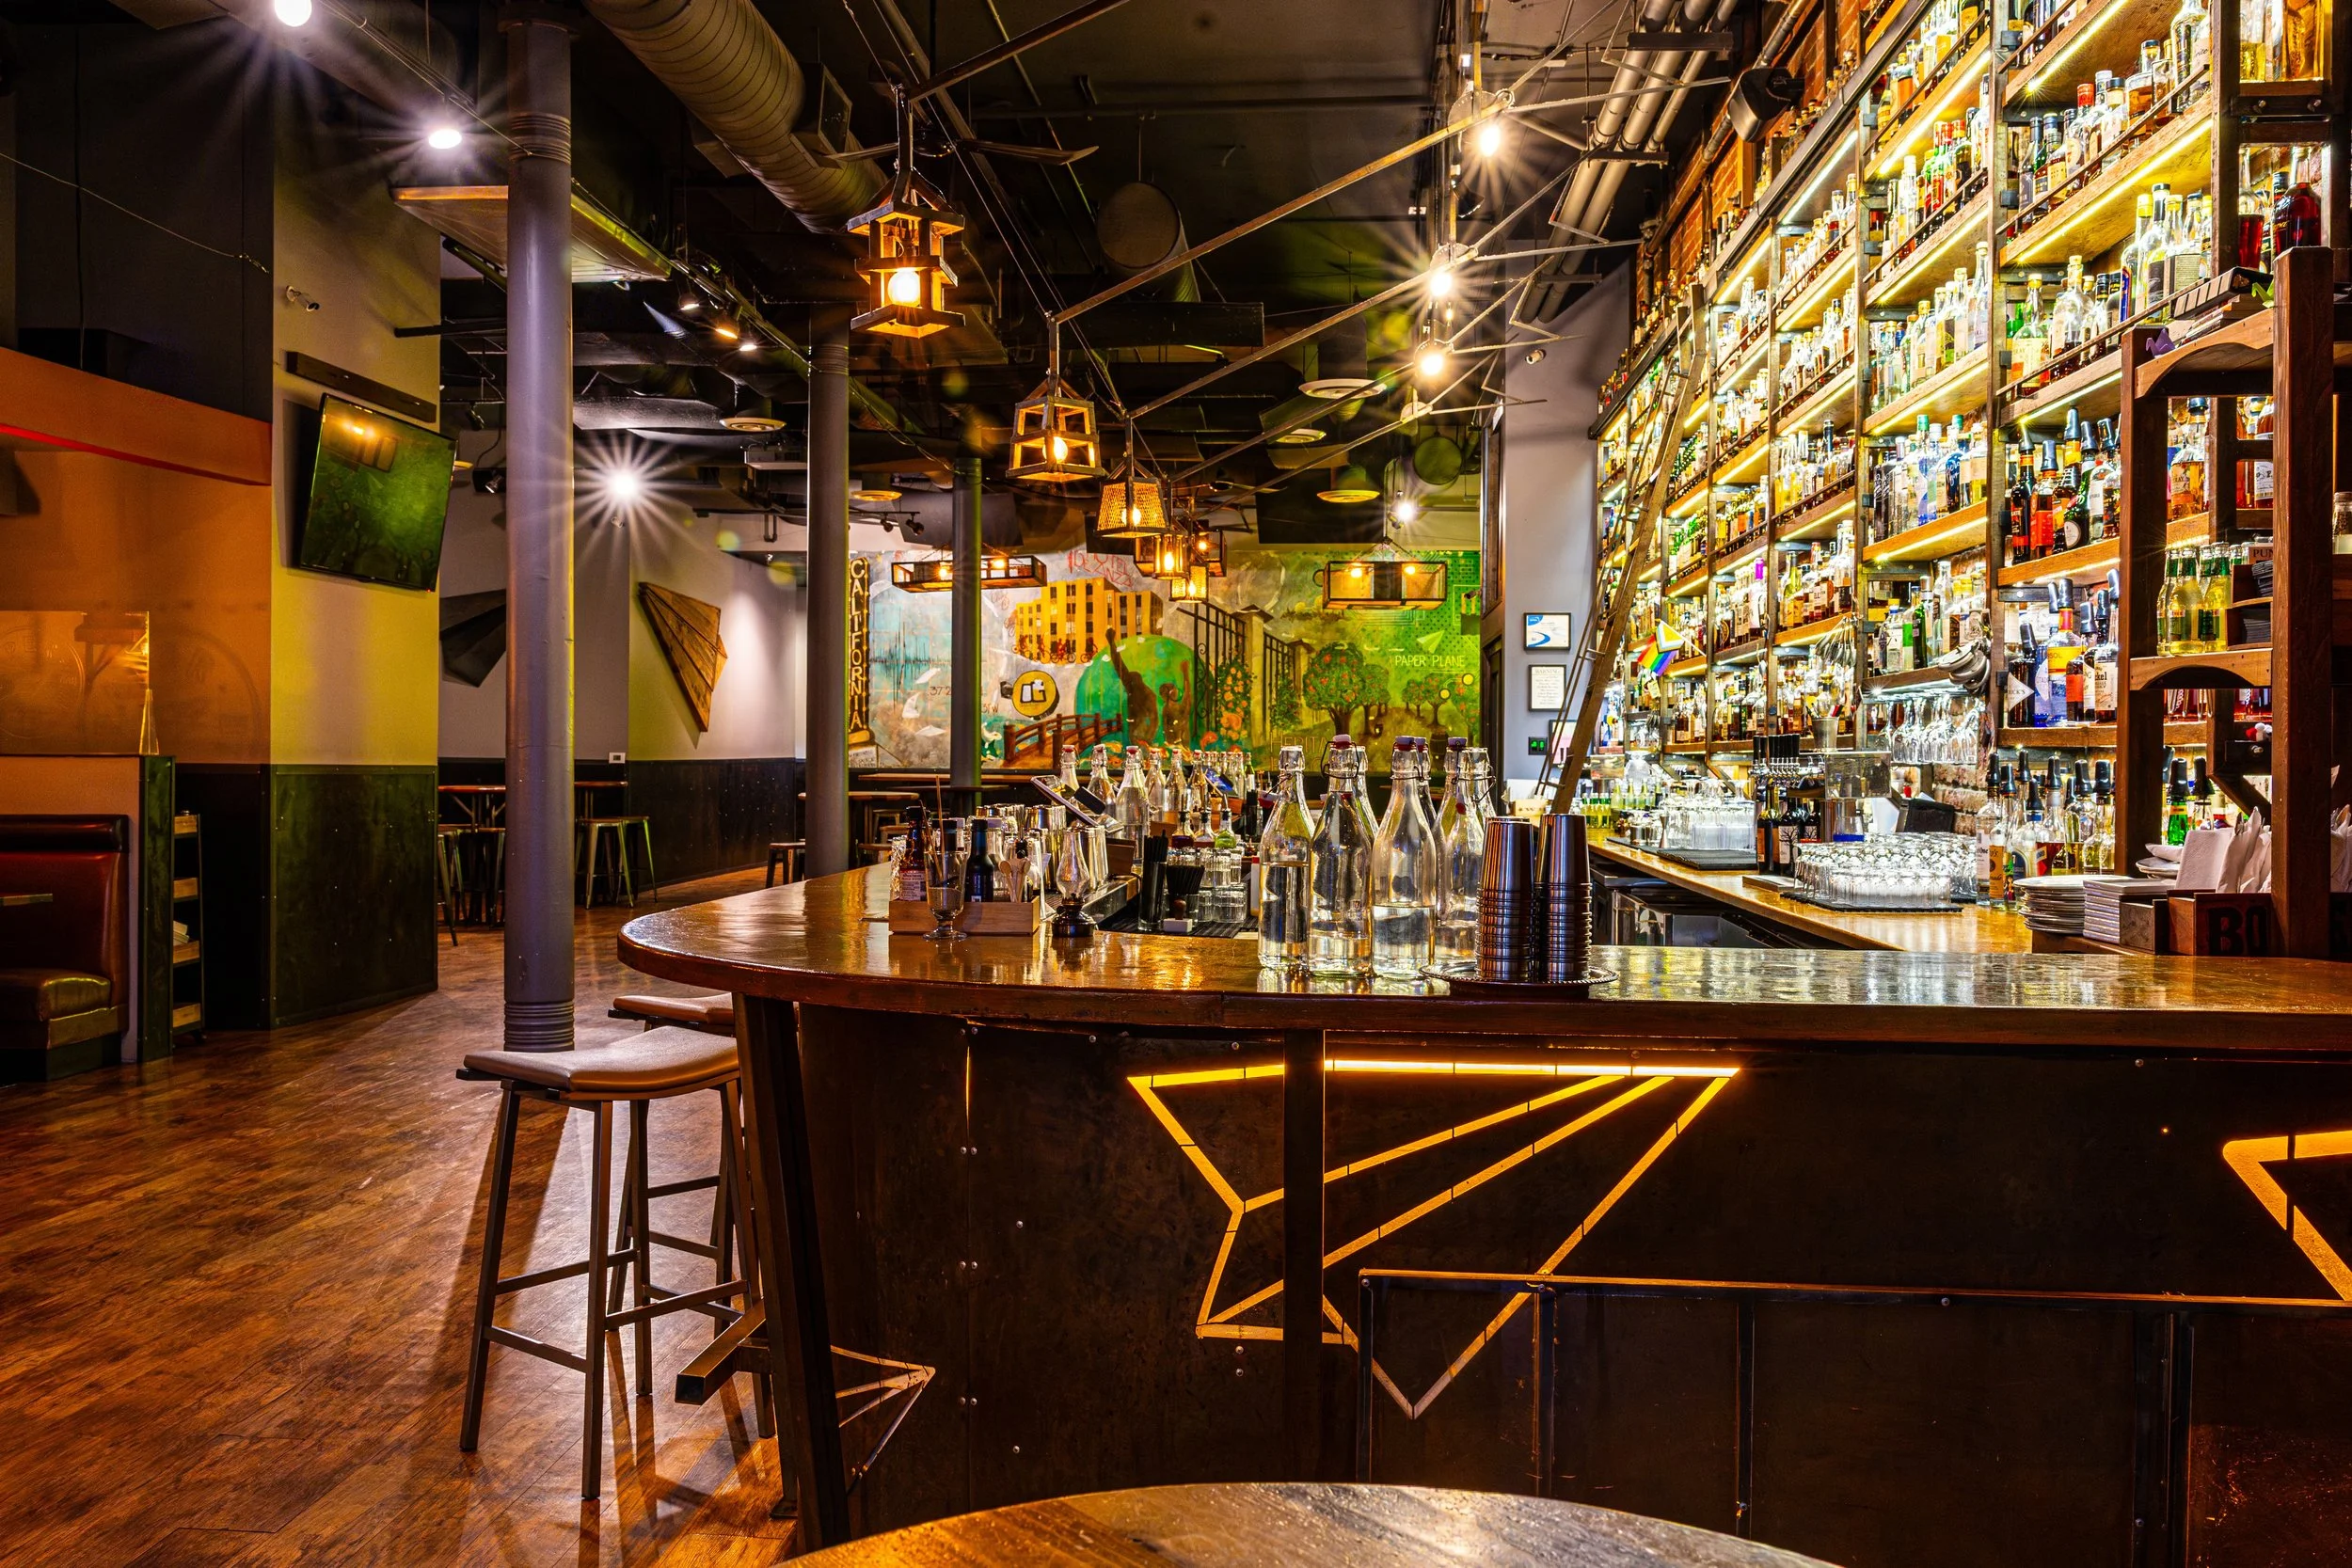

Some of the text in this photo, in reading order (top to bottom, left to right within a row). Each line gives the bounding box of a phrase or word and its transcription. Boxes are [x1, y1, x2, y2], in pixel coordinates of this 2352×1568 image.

[850, 559, 866, 730] CALIFORNIA
[1394, 655, 1466, 667] PAPER PLANE
